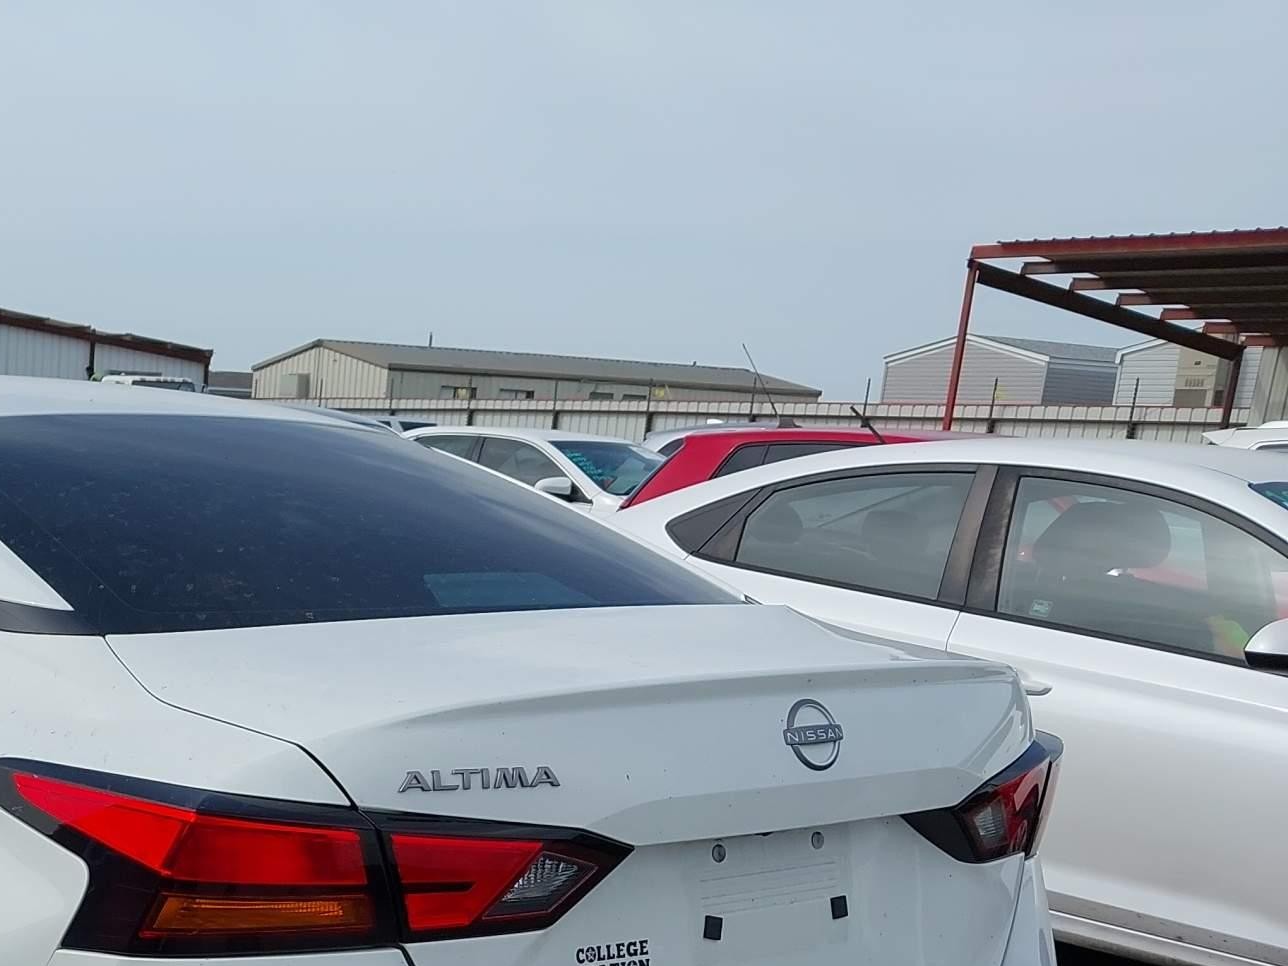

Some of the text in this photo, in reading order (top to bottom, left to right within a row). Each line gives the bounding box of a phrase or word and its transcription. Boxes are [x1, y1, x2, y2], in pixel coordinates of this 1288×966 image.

[786, 727, 843, 743] NISSAN
[398, 766, 561, 793] ALTIMA
[576, 939, 649, 964] COLLEGE
